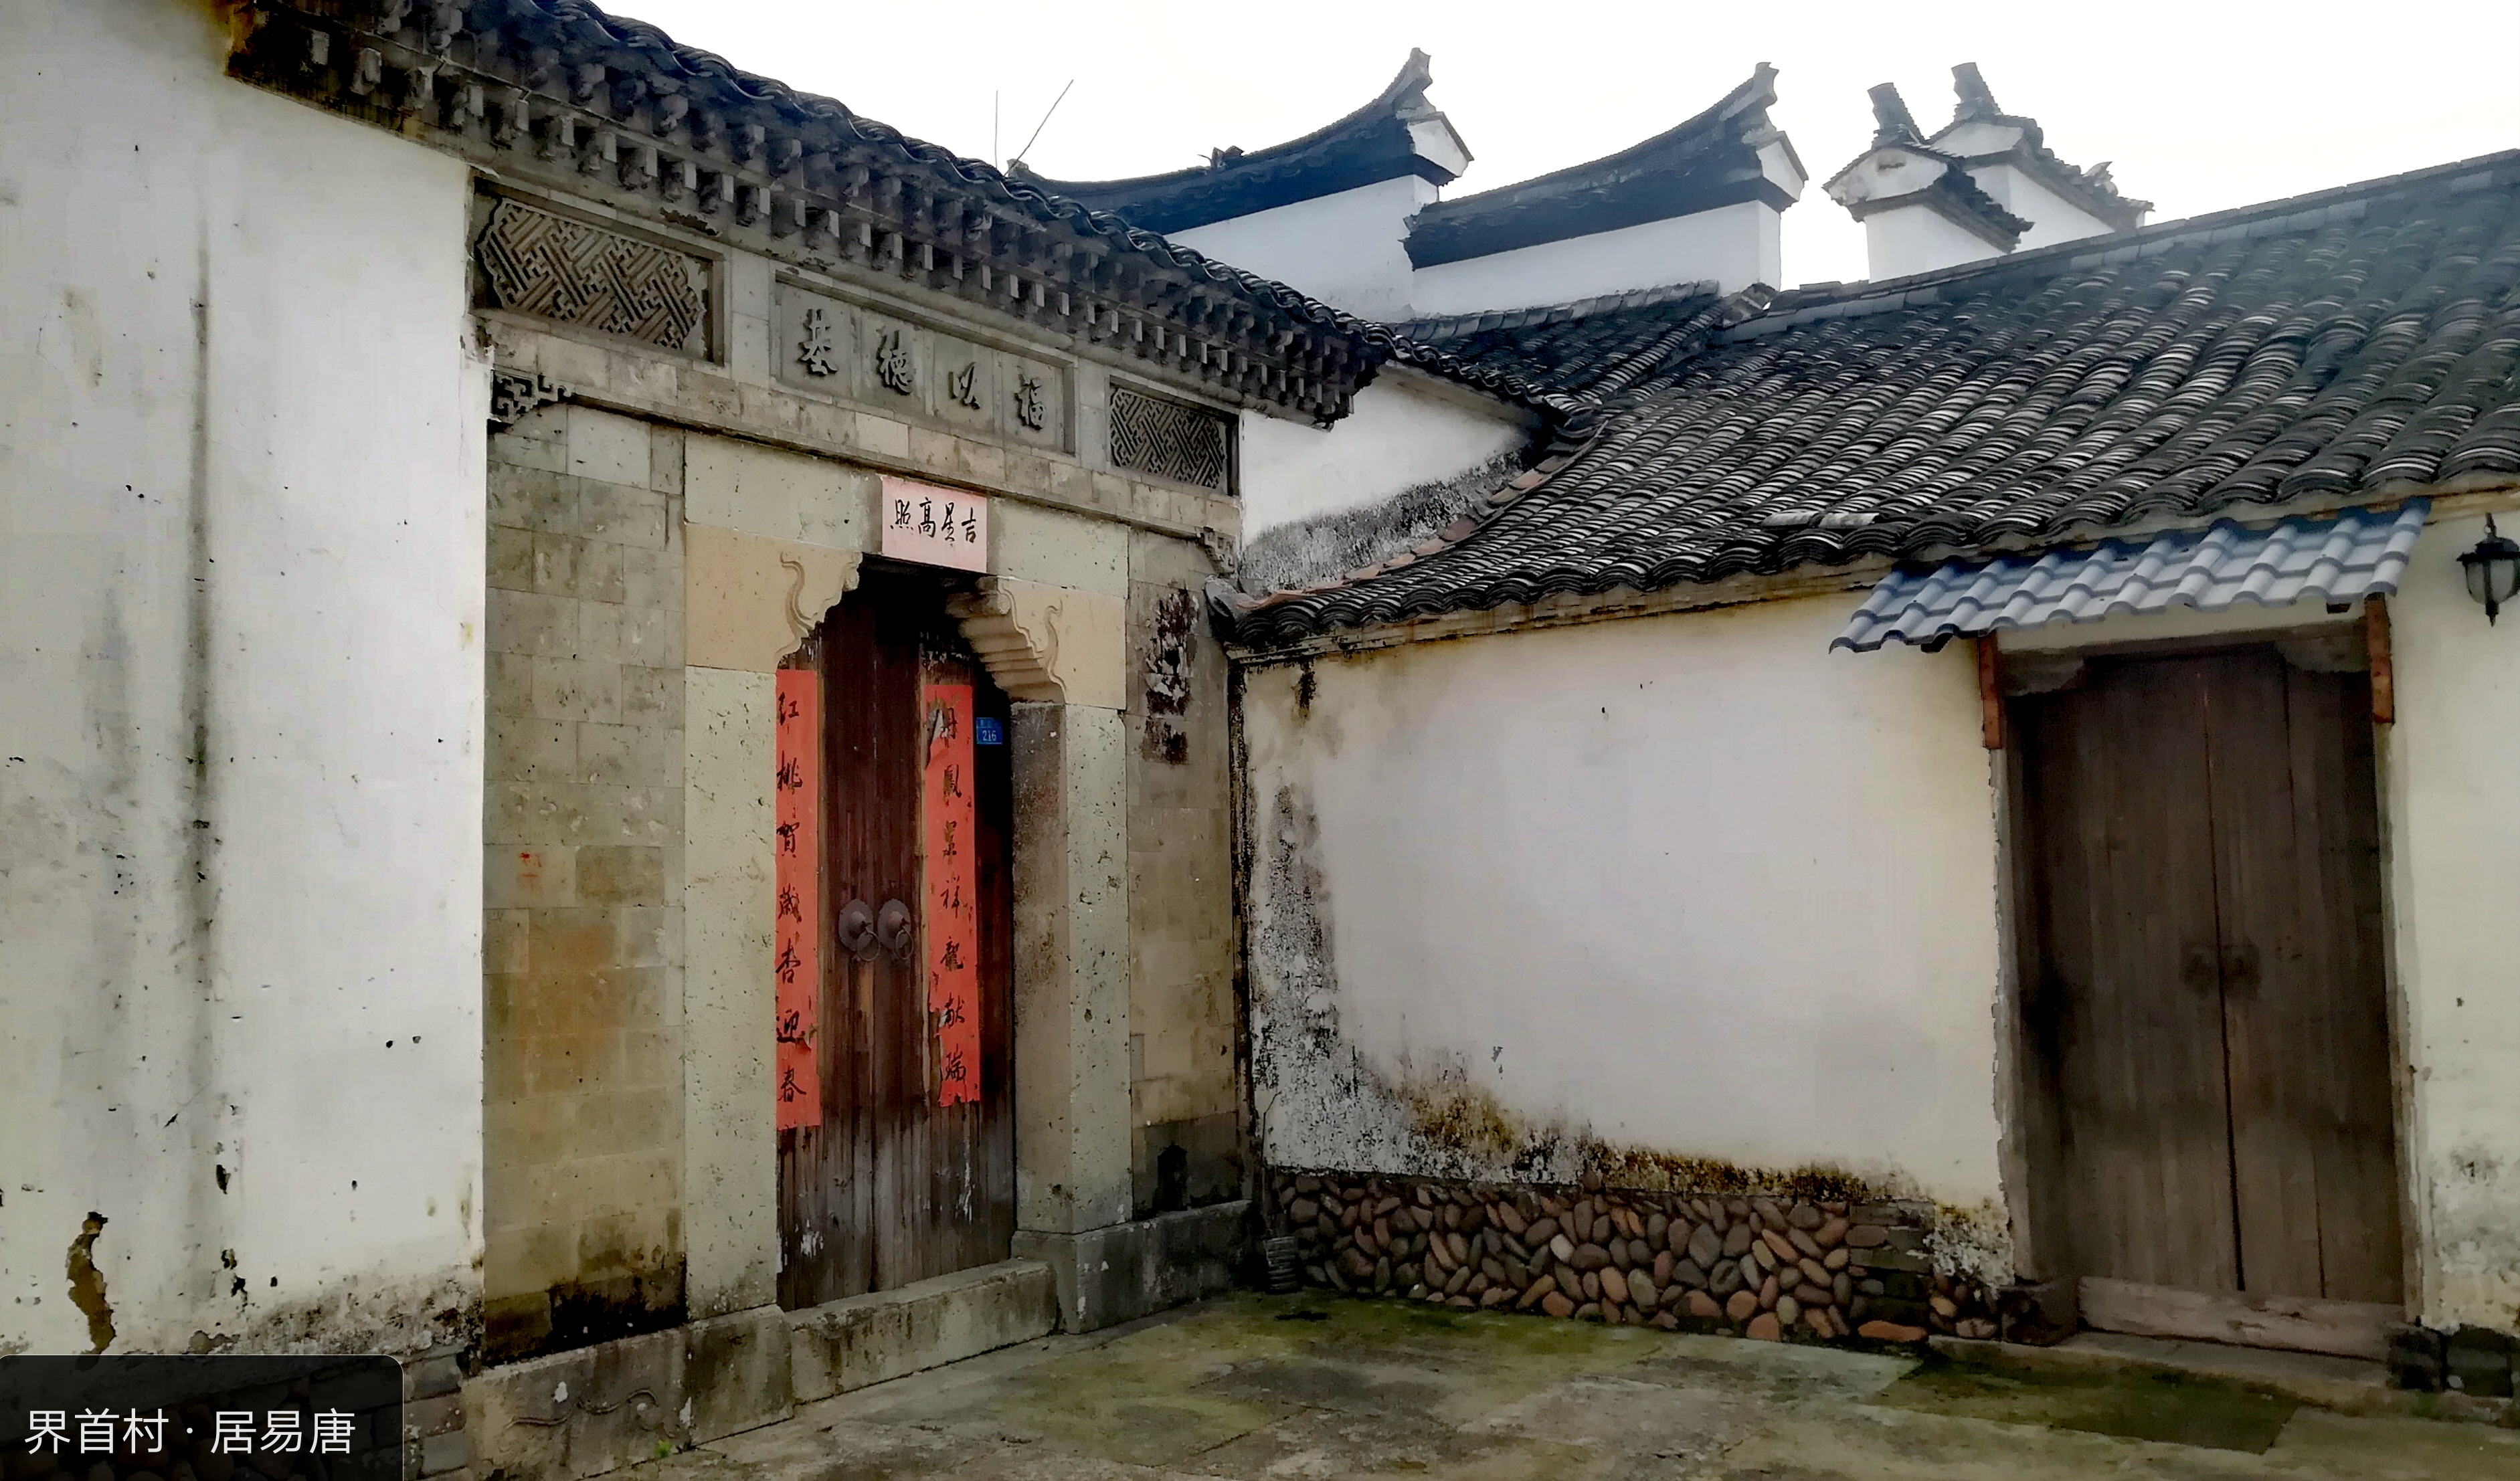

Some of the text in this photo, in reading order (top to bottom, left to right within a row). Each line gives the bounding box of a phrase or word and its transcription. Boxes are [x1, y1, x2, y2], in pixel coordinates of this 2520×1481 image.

[890, 497, 977, 547] 吉星高照
[982, 730, 997, 742] 216
